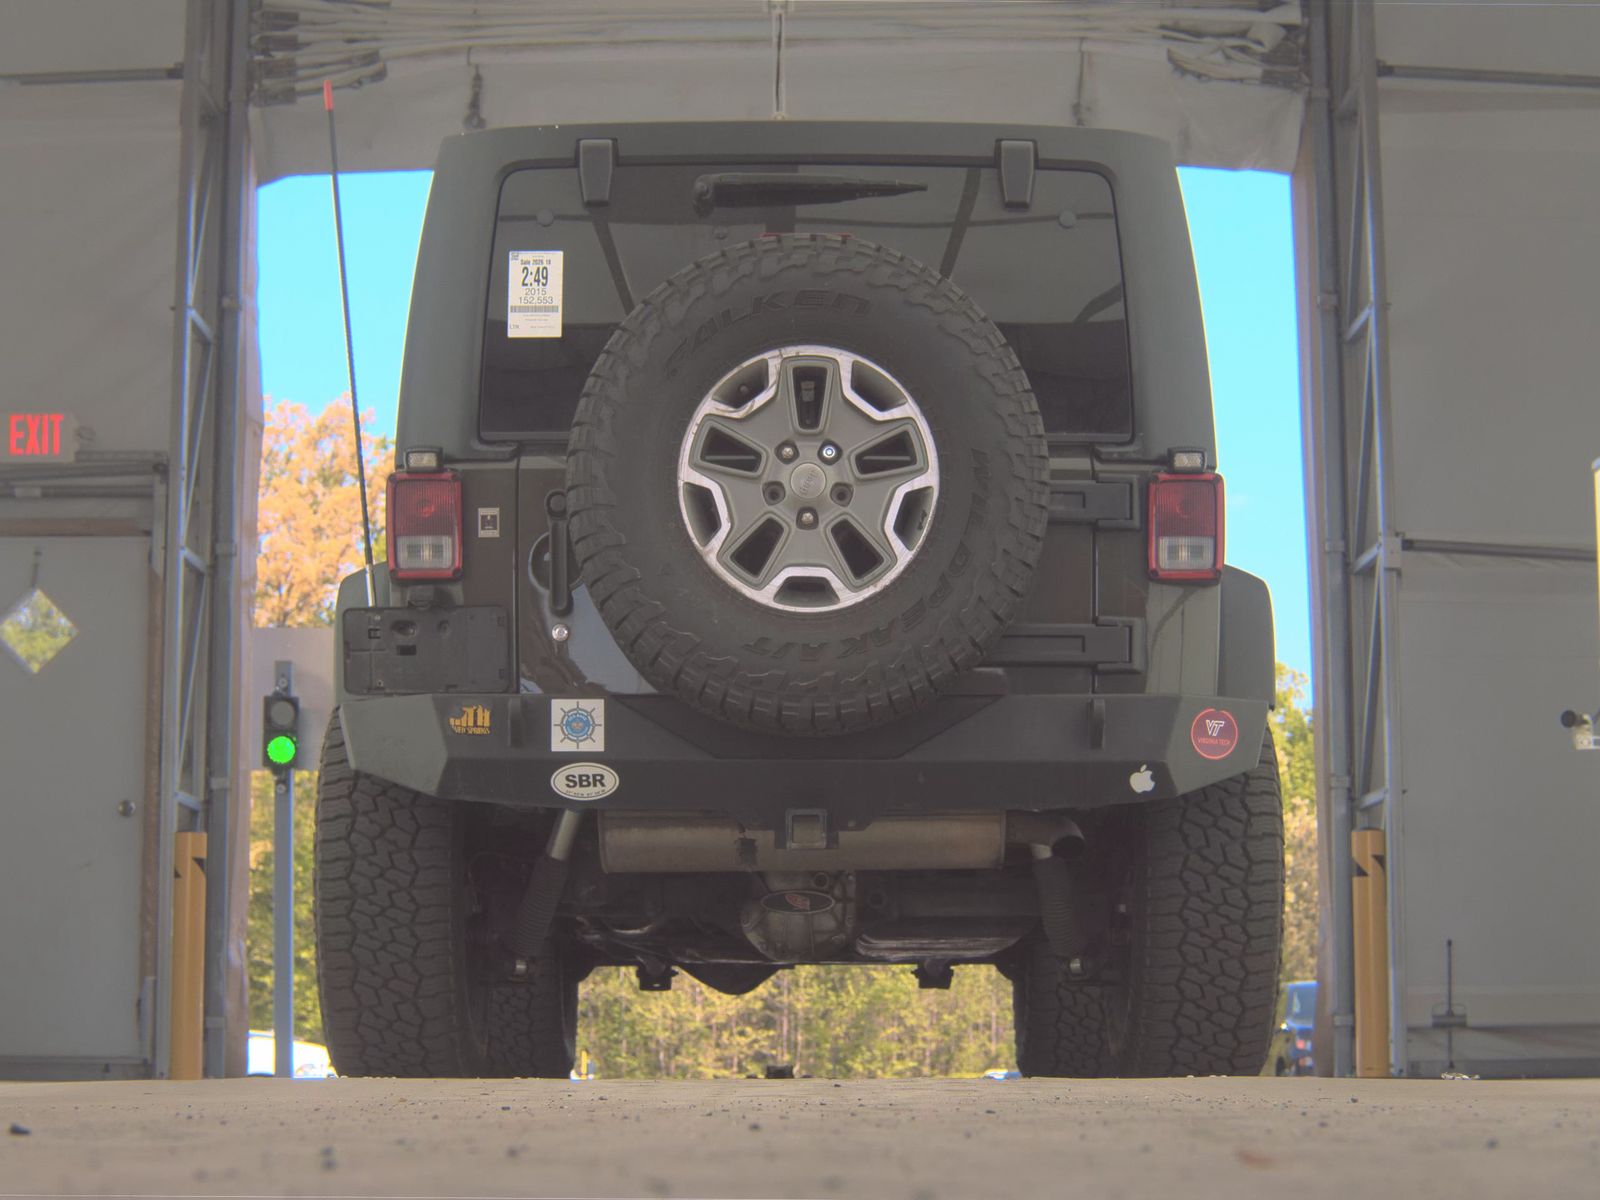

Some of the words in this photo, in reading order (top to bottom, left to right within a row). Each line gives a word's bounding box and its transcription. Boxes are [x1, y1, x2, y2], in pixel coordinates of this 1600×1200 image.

[521, 266, 549, 287] 2:49
[524, 288, 547, 296] 2015
[9, 413, 64, 456] EXIT
[1206, 719, 1225, 736] VT
[565, 773, 606, 788] SBR
